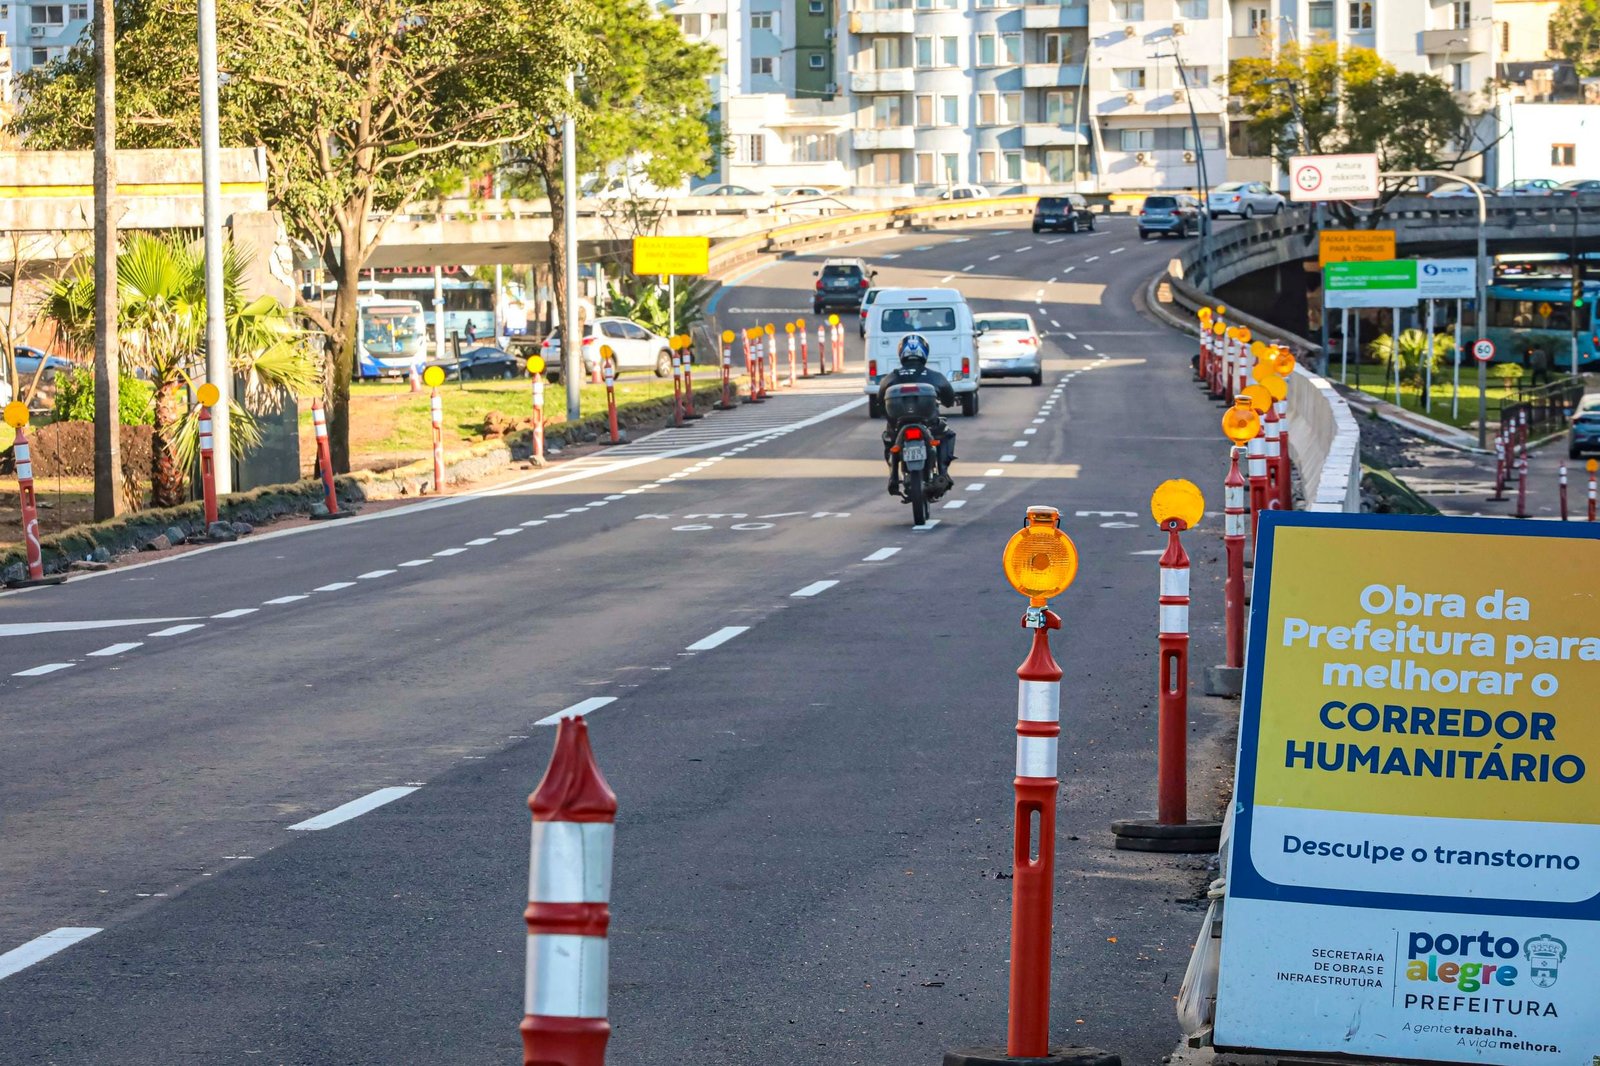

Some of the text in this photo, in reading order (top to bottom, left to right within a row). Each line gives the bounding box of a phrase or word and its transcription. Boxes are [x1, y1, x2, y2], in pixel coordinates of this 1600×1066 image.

[1328, 184, 1369, 193] permitida
[1477, 345, 1491, 354] 60
[1359, 584, 1530, 621] Obra da
[1282, 617, 1600, 665] Prefeitura para
[1322, 659, 1559, 697] melhorar o
[1319, 700, 1557, 741] CORREDOR
[1284, 740, 1586, 784] HUMANITÁRIO
[1282, 835, 1580, 870] Desculpe o transtorno
[1312, 948, 1385, 962] SECRETARIA
[1408, 930, 1520, 960] porto
[1276, 972, 1383, 988] INFRAESTRUTURA
[1314, 961, 1384, 975] DE OBRAS E
[1406, 955, 1518, 993] alegre
[1405, 993, 1559, 1018] PREFEITURA
[1402, 1022, 1518, 1038] A gente trabalha.
[1457, 1037, 1561, 1053] A vida melhora.
